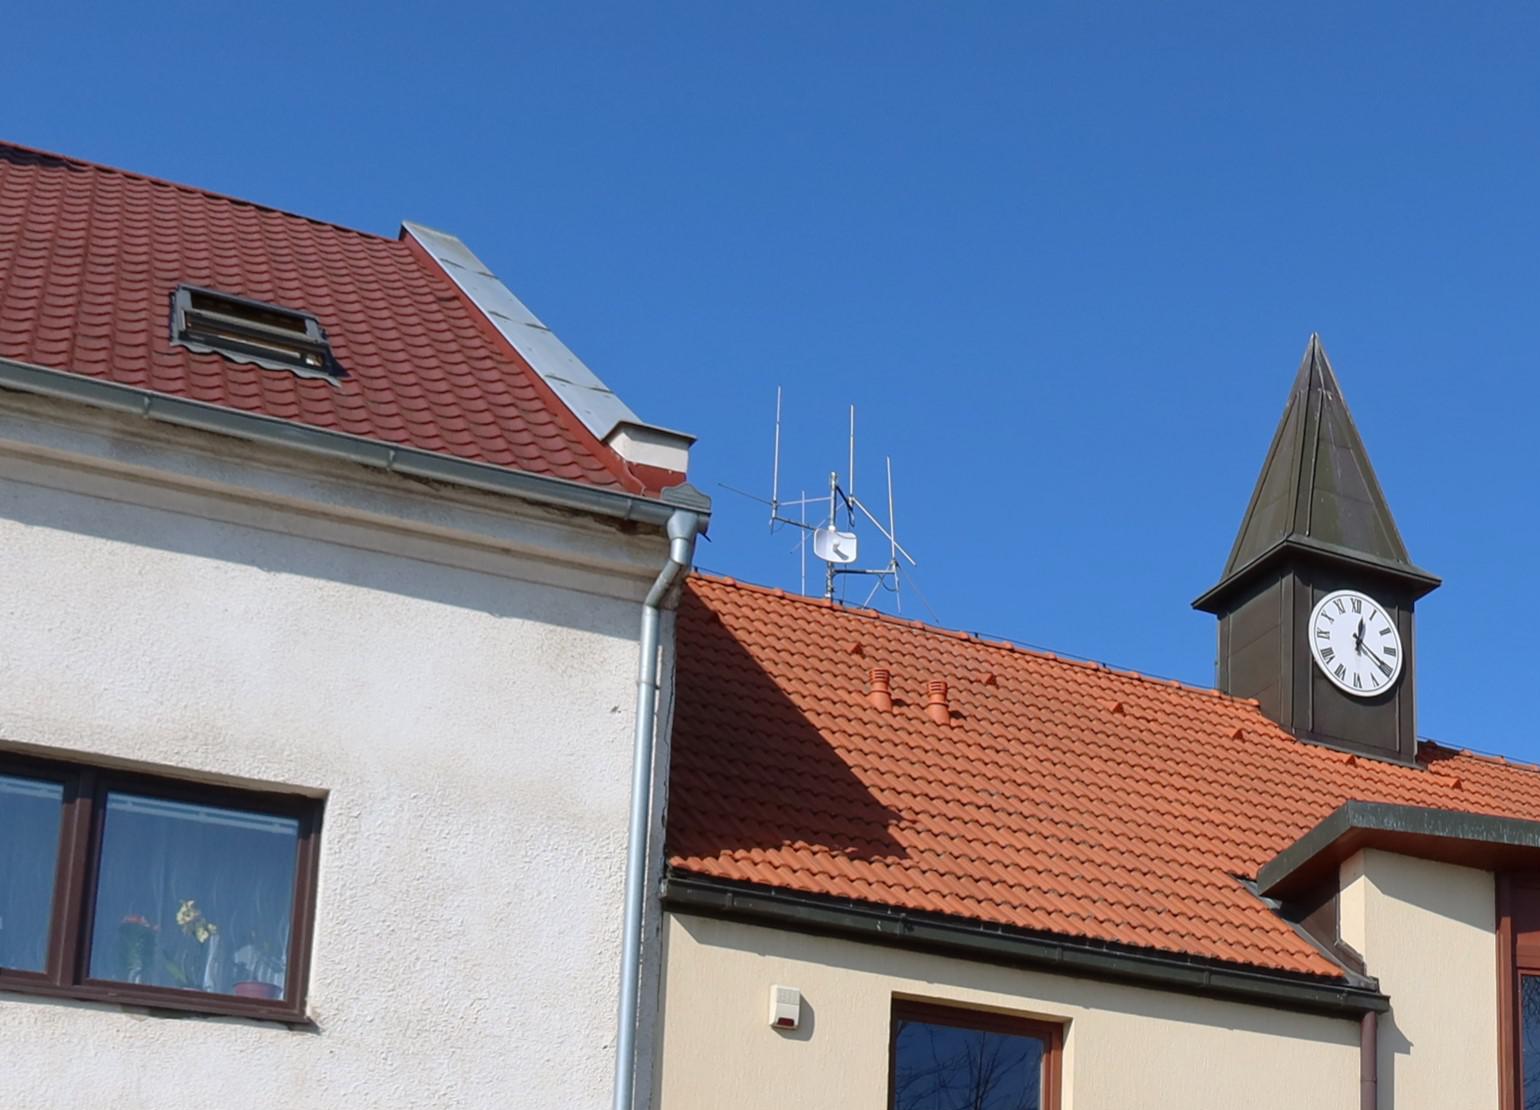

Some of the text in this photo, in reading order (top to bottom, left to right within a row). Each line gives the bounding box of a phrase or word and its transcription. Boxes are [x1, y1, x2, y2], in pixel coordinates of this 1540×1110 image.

[1333, 598, 1346, 615] XI
[1350, 598, 1362, 614] XII
[1321, 610, 1334, 624] X
[1317, 627, 1330, 640] IX
[1379, 627, 1391, 636] II
[1320, 647, 1335, 664] VIII
[1383, 646, 1396, 657] III
[1334, 663, 1346, 681] VII
[1353, 672, 1362, 688] VI
[1370, 672, 1379, 688] V
